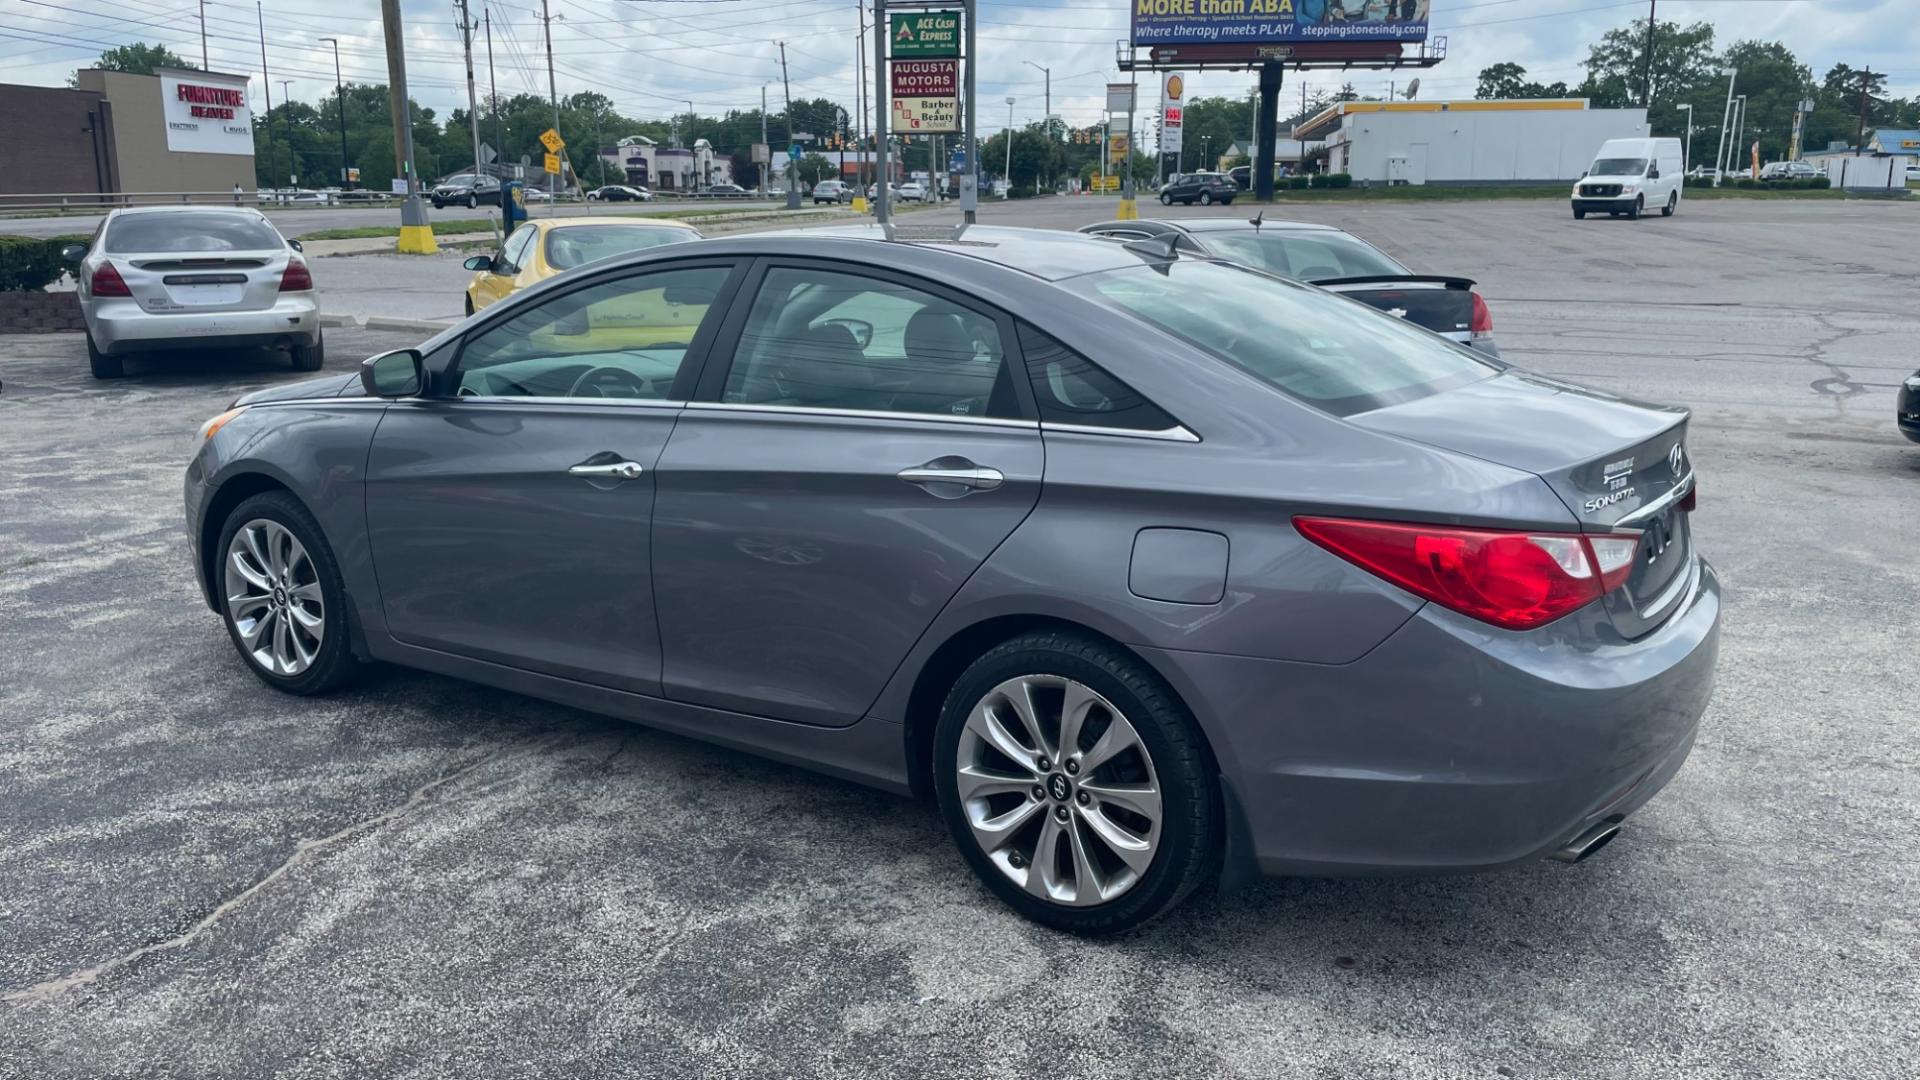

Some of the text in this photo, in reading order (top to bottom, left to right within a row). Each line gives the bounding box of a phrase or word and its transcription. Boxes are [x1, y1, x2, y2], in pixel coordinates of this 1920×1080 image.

[1136, 0, 1293, 15] MORE than ABA
[917, 18, 934, 29] ACE
[1136, 23, 1293, 39] Where therapy meets PLAY!
[1302, 24, 1425, 37] steppingstonesindy.com
[894, 63, 954, 73] AUGUSTA
[897, 75, 951, 86] MOTORS
[177, 84, 245, 107] FURNITURE
[921, 101, 954, 109] Barber
[191, 106, 234, 119] HEAVEN
[921, 112, 953, 122] Beauty
[1584, 487, 1635, 513] SONATA
